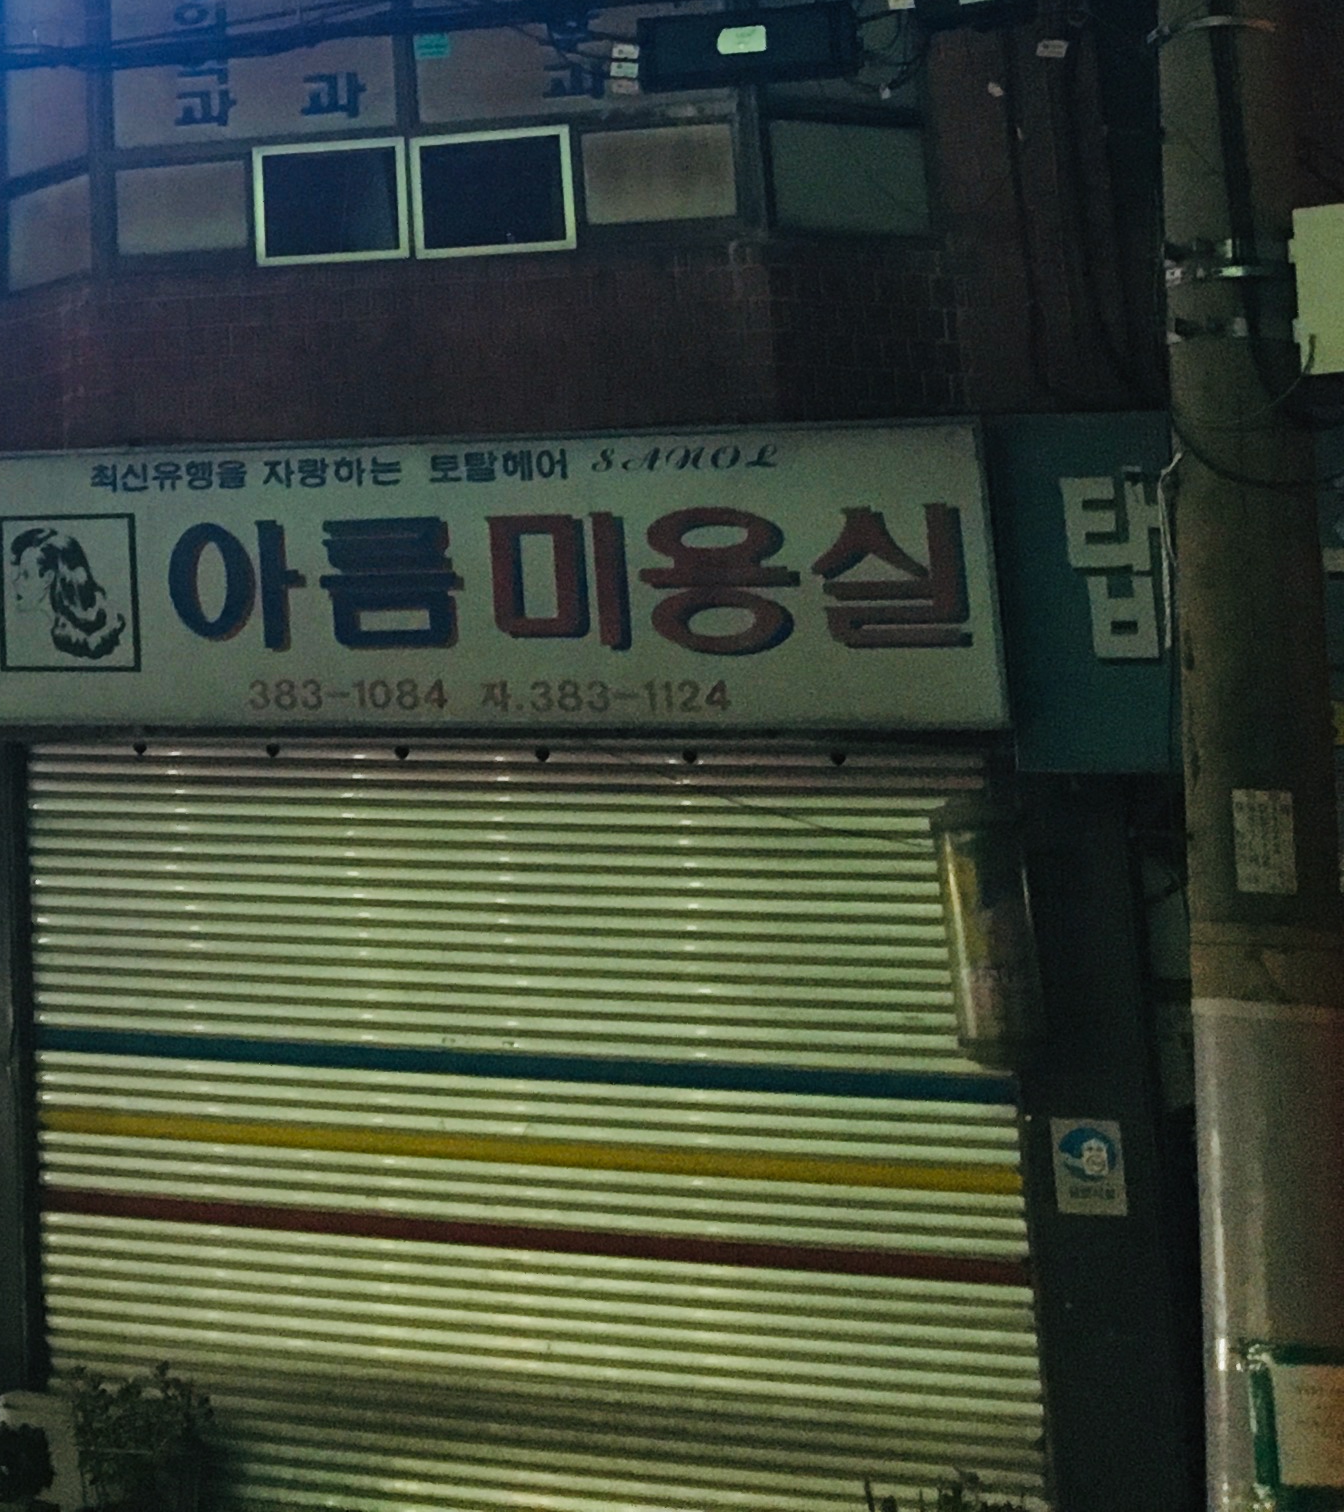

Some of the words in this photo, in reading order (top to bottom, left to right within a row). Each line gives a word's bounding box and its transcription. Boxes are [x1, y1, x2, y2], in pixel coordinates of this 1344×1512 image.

[89, 459, 248, 493] 최신유행을
[262, 455, 401, 490] 자랑하는
[428, 448, 570, 484] 토탈헤어
[247, 677, 450, 713] 383-1084
